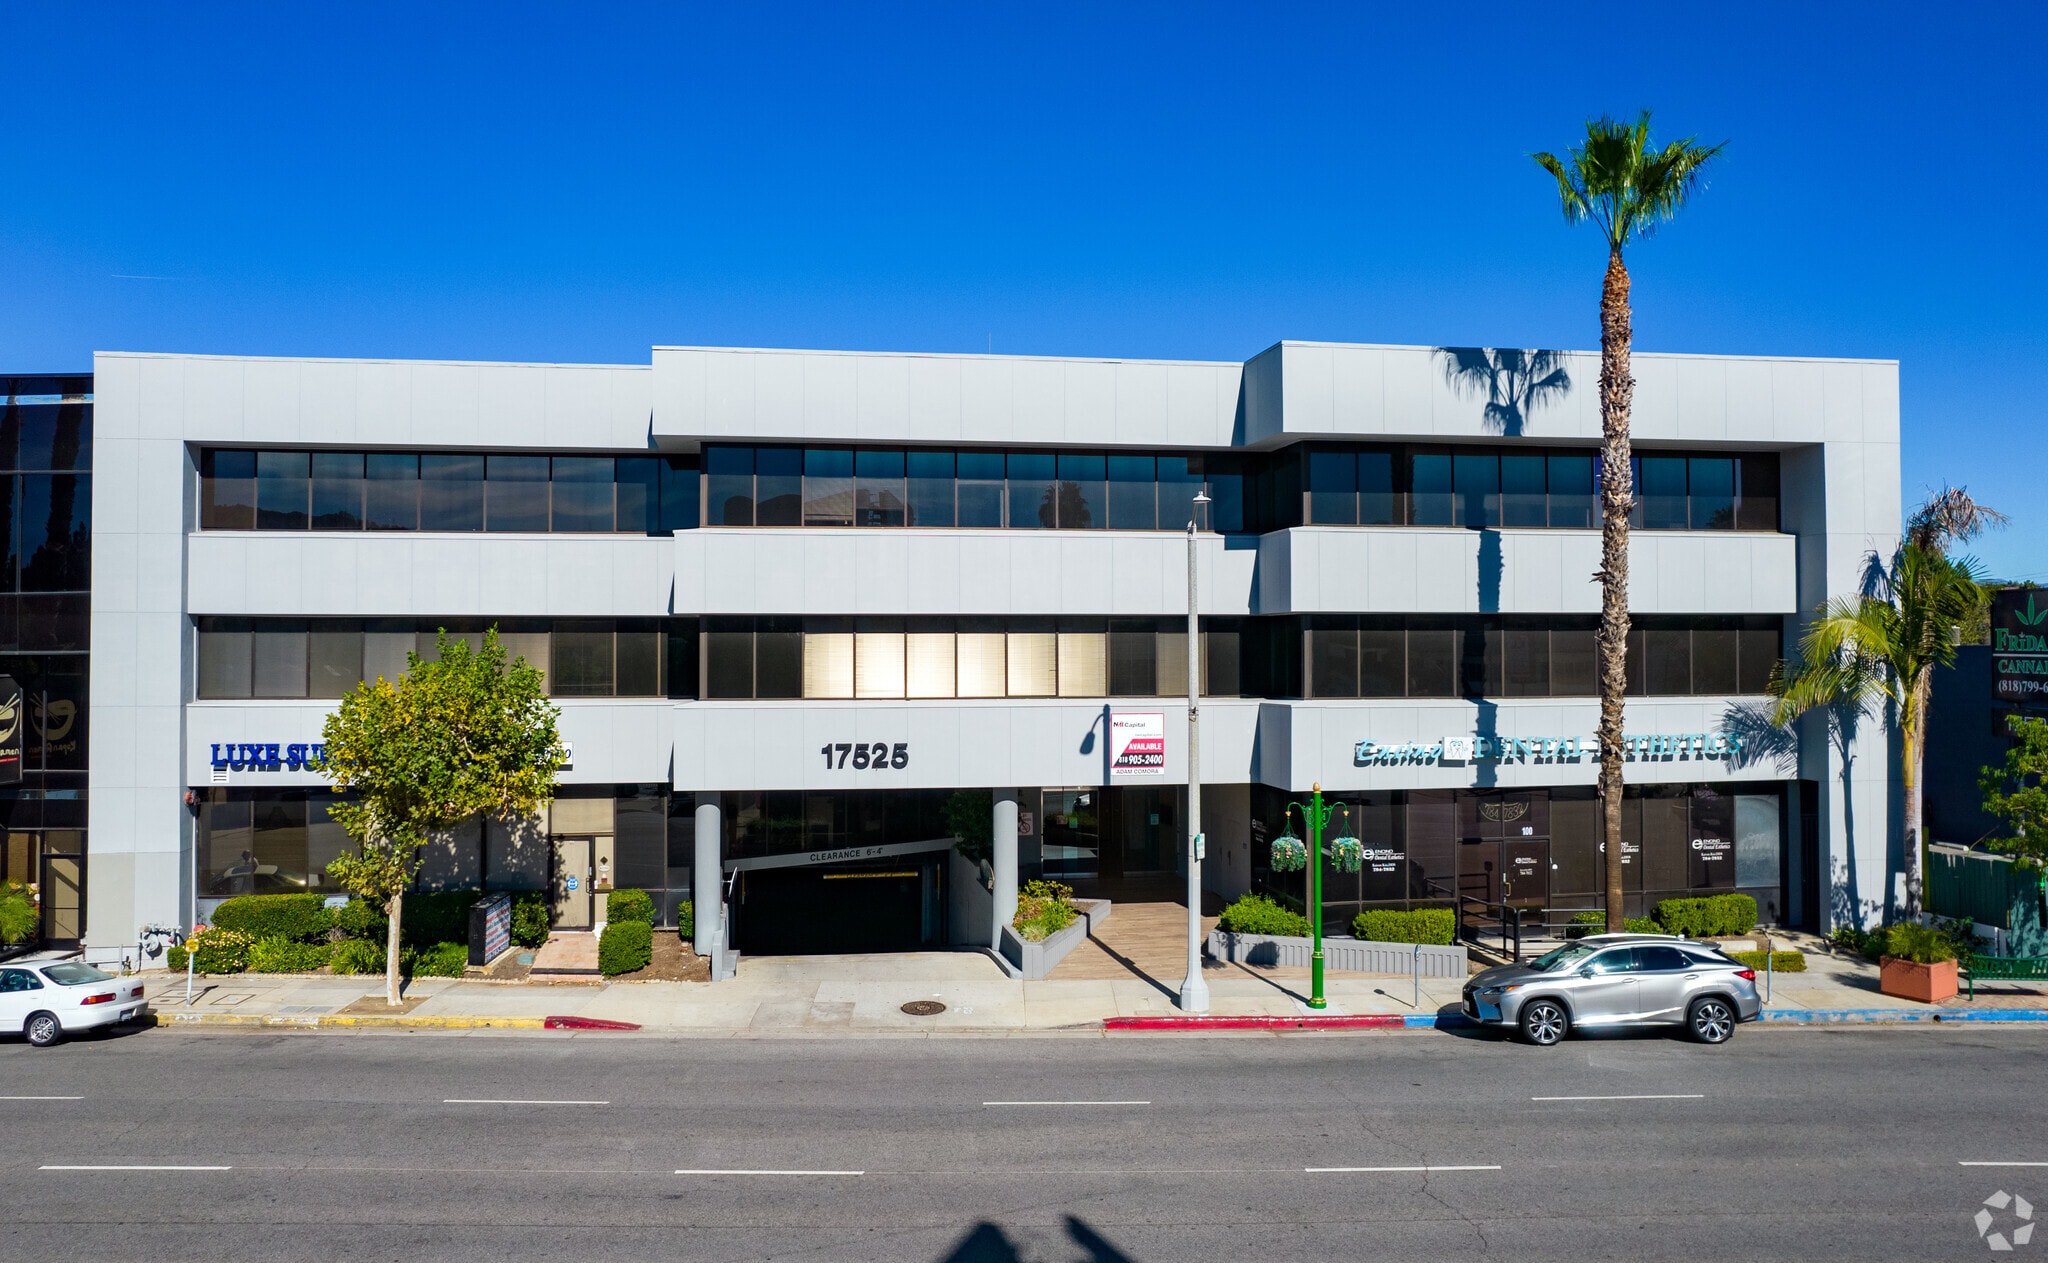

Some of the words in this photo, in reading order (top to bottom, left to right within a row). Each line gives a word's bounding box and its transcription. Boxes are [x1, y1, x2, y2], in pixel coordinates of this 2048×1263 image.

[1128, 742, 1163, 750] AVAILABLE
[1356, 738, 1443, 760] Encino
[210, 743, 280, 766] LUXE
[821, 742, 909, 770] 17525
[1118, 756, 1128, 764] 818
[1128, 754, 1163, 765] 905-2400
[1521, 826, 1533, 836] 100
[810, 850, 860, 861] CLEARANCE
